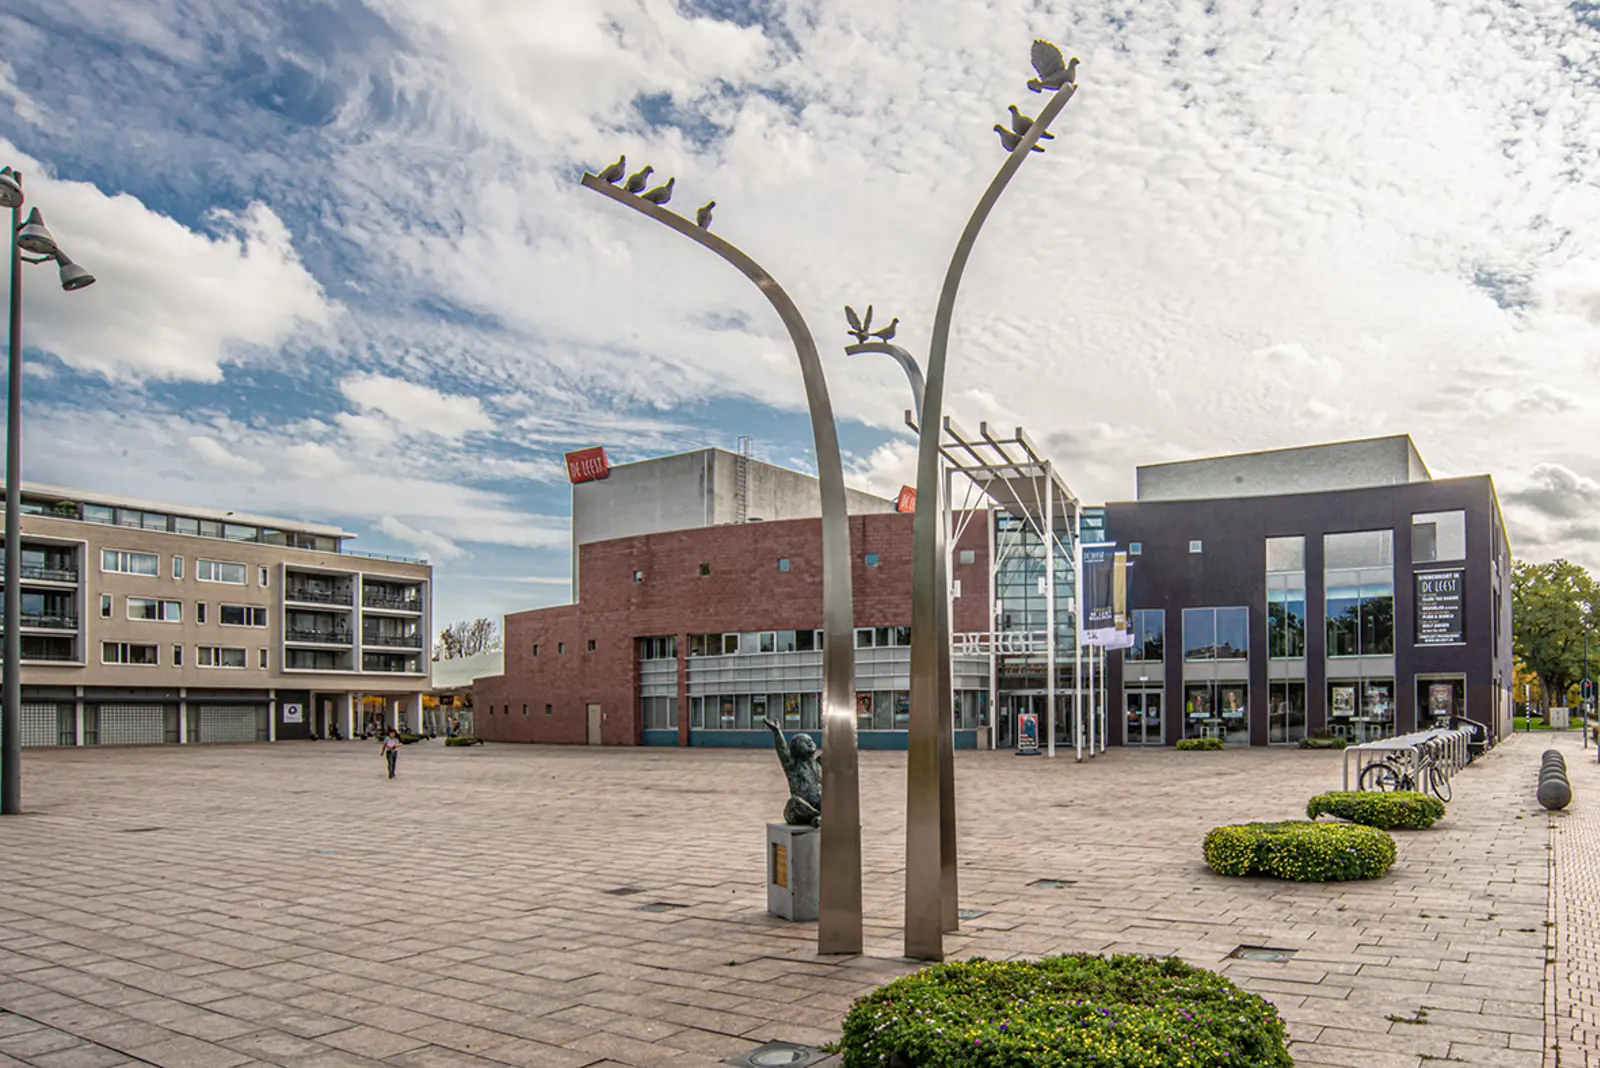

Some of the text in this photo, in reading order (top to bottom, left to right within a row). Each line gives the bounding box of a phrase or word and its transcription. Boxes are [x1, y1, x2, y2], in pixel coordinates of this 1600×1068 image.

[570, 457, 603, 478] DE LEEST
[1422, 579, 1457, 592] DE LEEST
